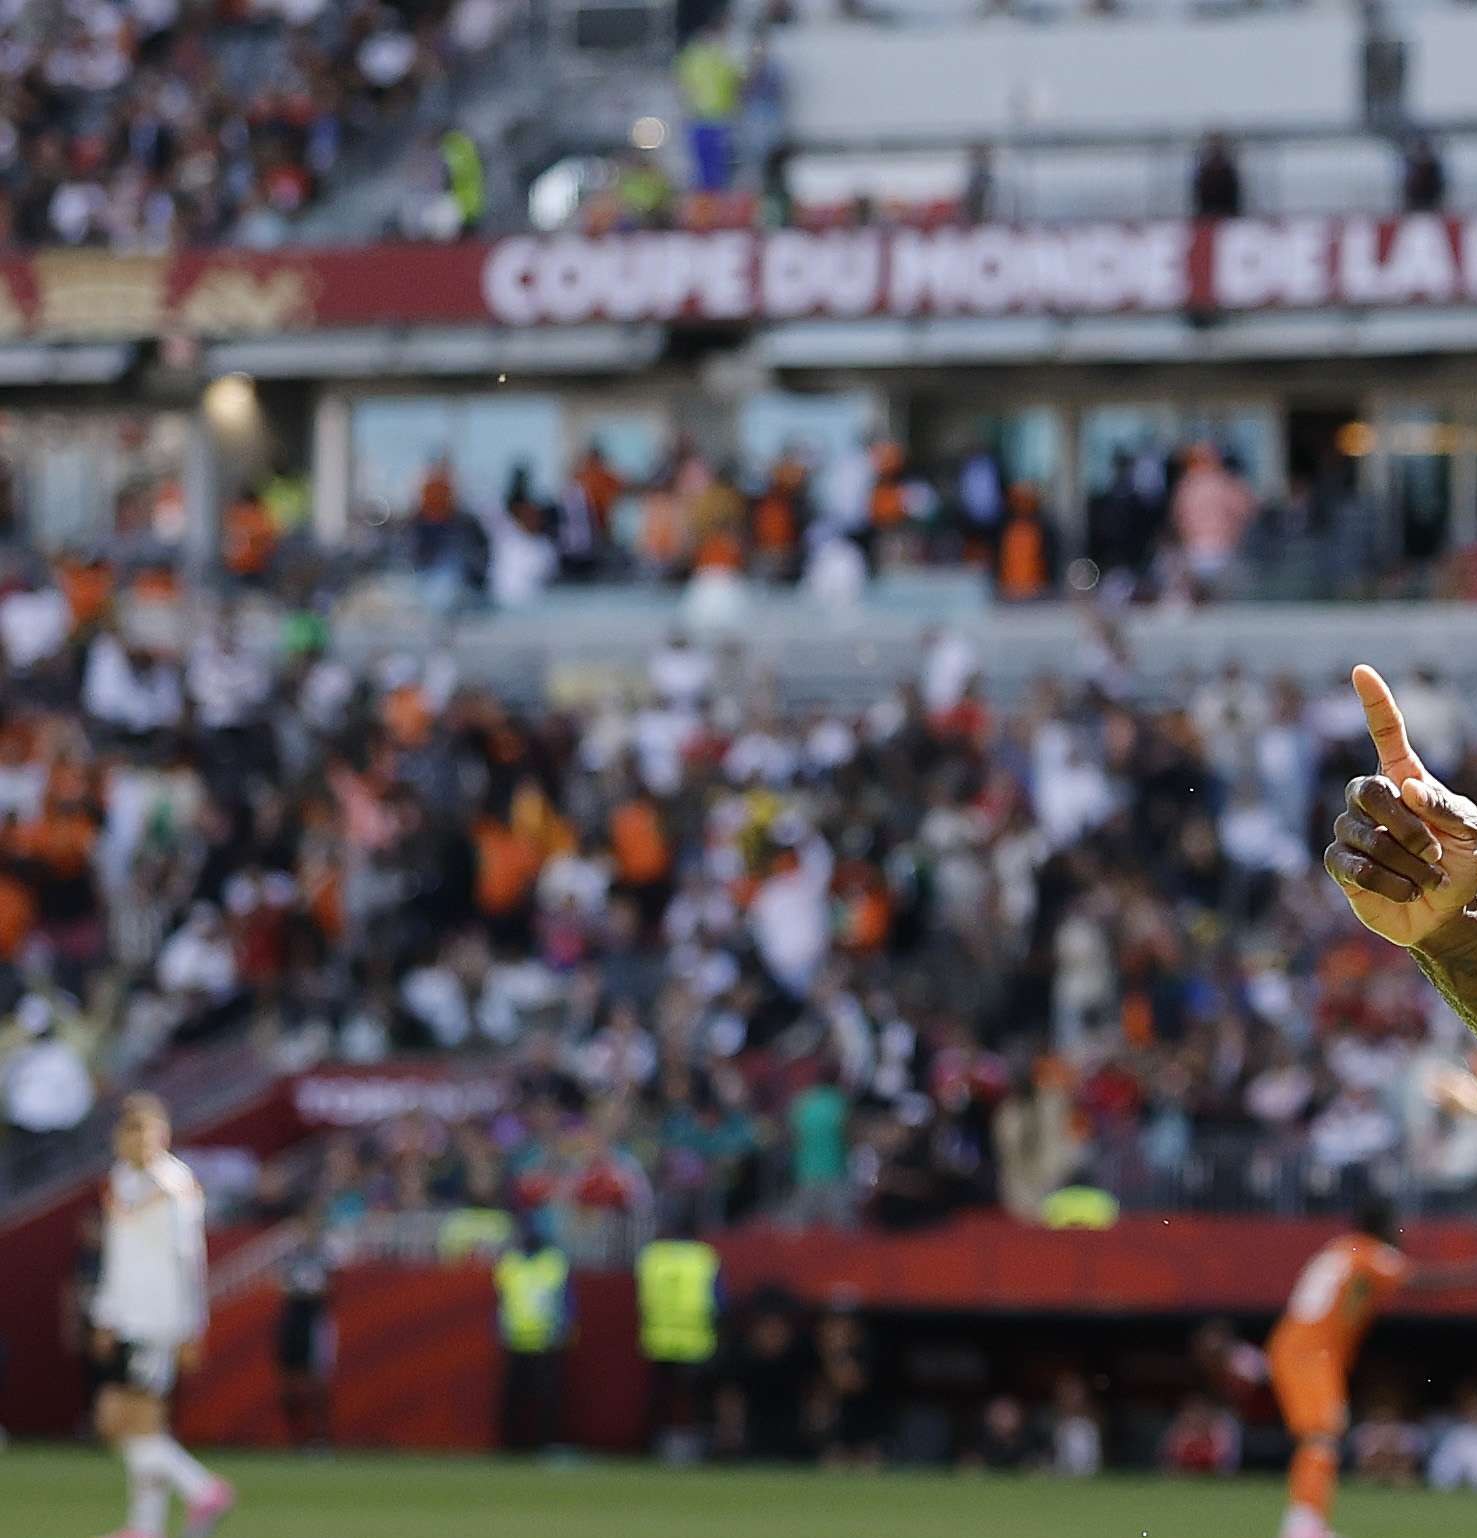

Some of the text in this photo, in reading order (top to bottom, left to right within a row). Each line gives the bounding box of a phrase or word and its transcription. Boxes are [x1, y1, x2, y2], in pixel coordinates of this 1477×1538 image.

[484, 232, 756, 324] COUPE
[762, 229, 880, 317] DU
[890, 222, 1190, 316] MONDE
[1212, 214, 1333, 306] DE
[1338, 211, 1457, 303] LA
